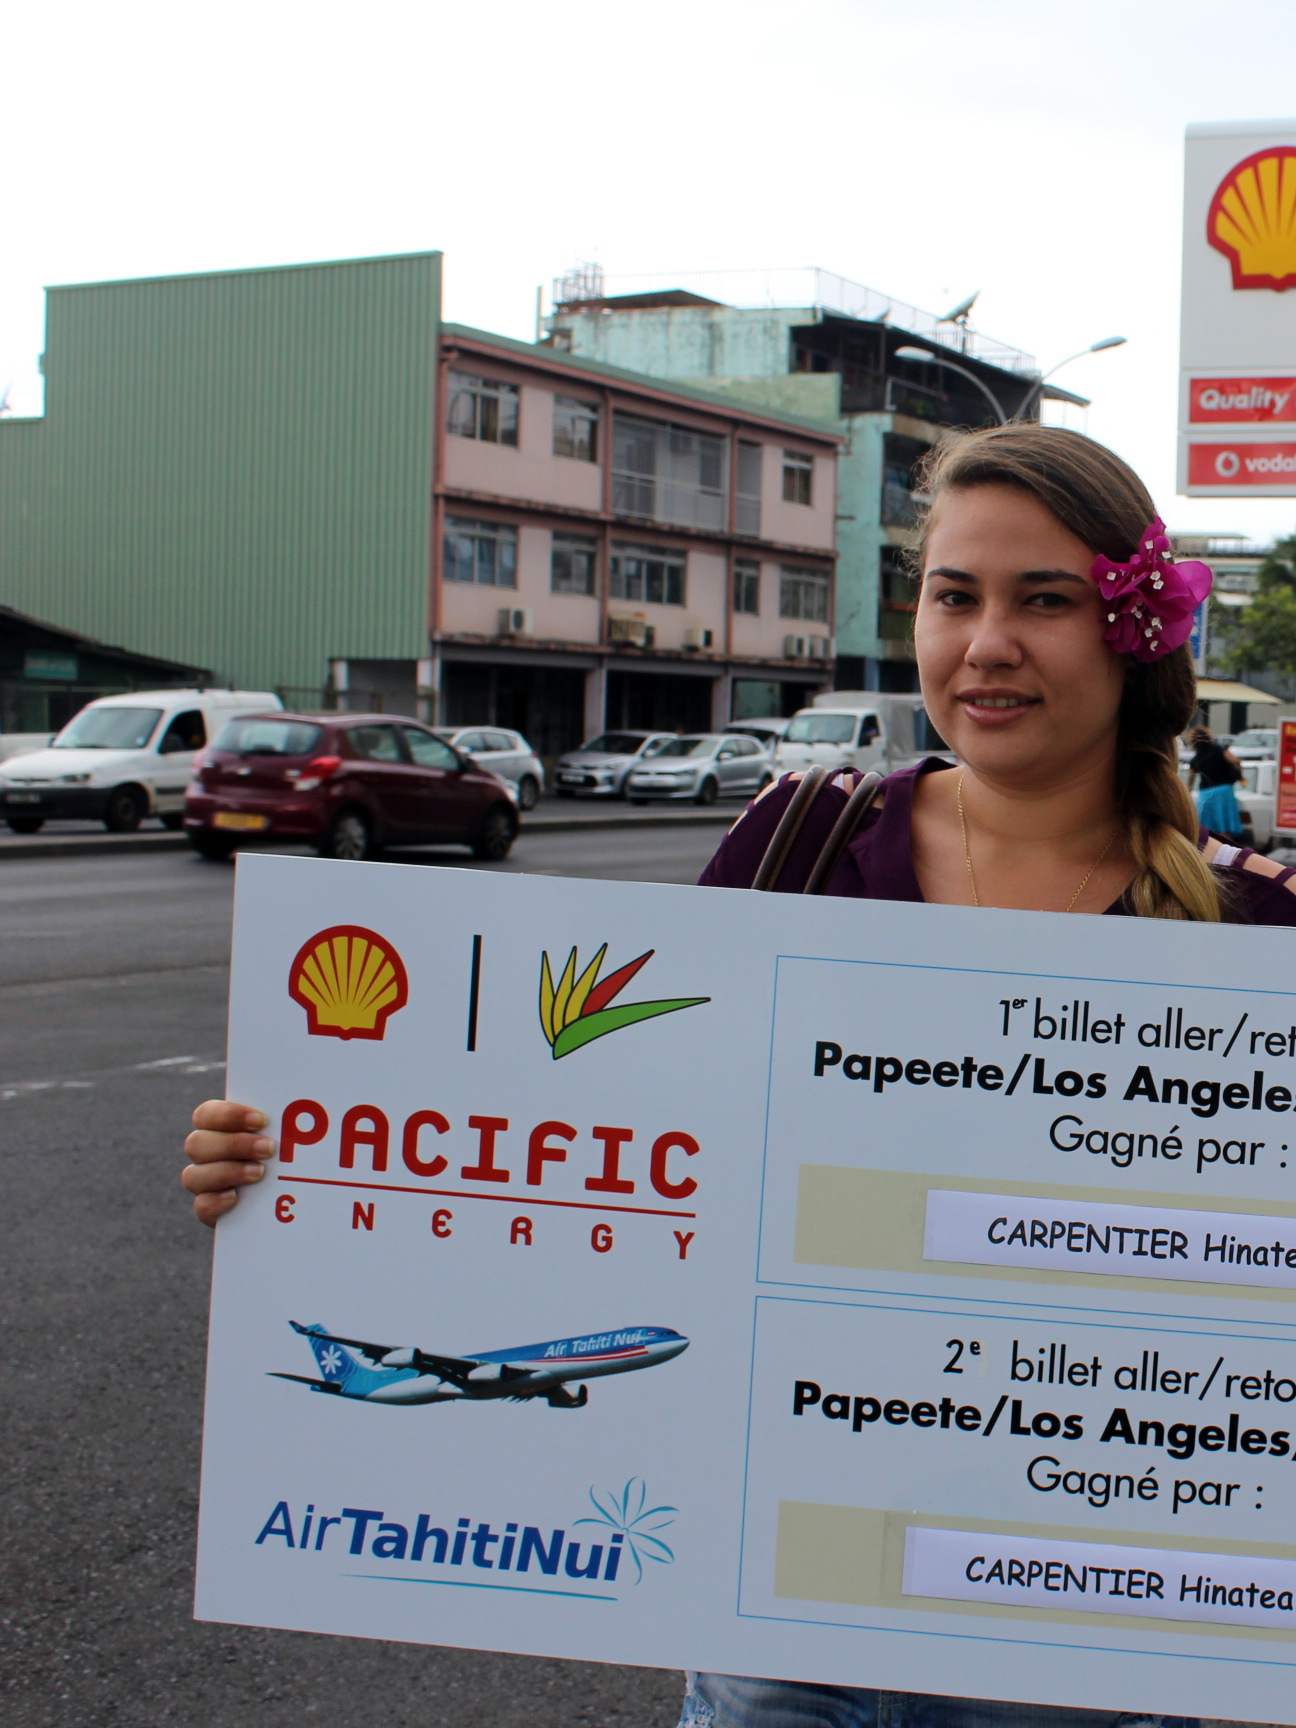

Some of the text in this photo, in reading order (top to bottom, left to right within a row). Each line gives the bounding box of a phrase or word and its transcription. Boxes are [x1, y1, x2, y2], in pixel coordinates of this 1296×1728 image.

[1200, 386, 1290, 414] Quality
[1033, 997, 1126, 1045] billet
[813, 1040, 1107, 1099] Papeete/Los
[279, 1098, 702, 1200] PACIFIC
[1049, 1114, 1183, 1168] Gagné
[1196, 1138, 1266, 1174] par
[987, 1216, 1189, 1260] CARPENTIER
[543, 1343, 568, 1358] Air
[571, 1333, 612, 1354] Tahiti
[1010, 1339, 1103, 1387] billet
[793, 1380, 1084, 1441] Papeete/Los
[1026, 1455, 1159, 1508] Gagné
[1172, 1479, 1241, 1515] par
[965, 1556, 1294, 1611] CARPENTIER Hinatea
